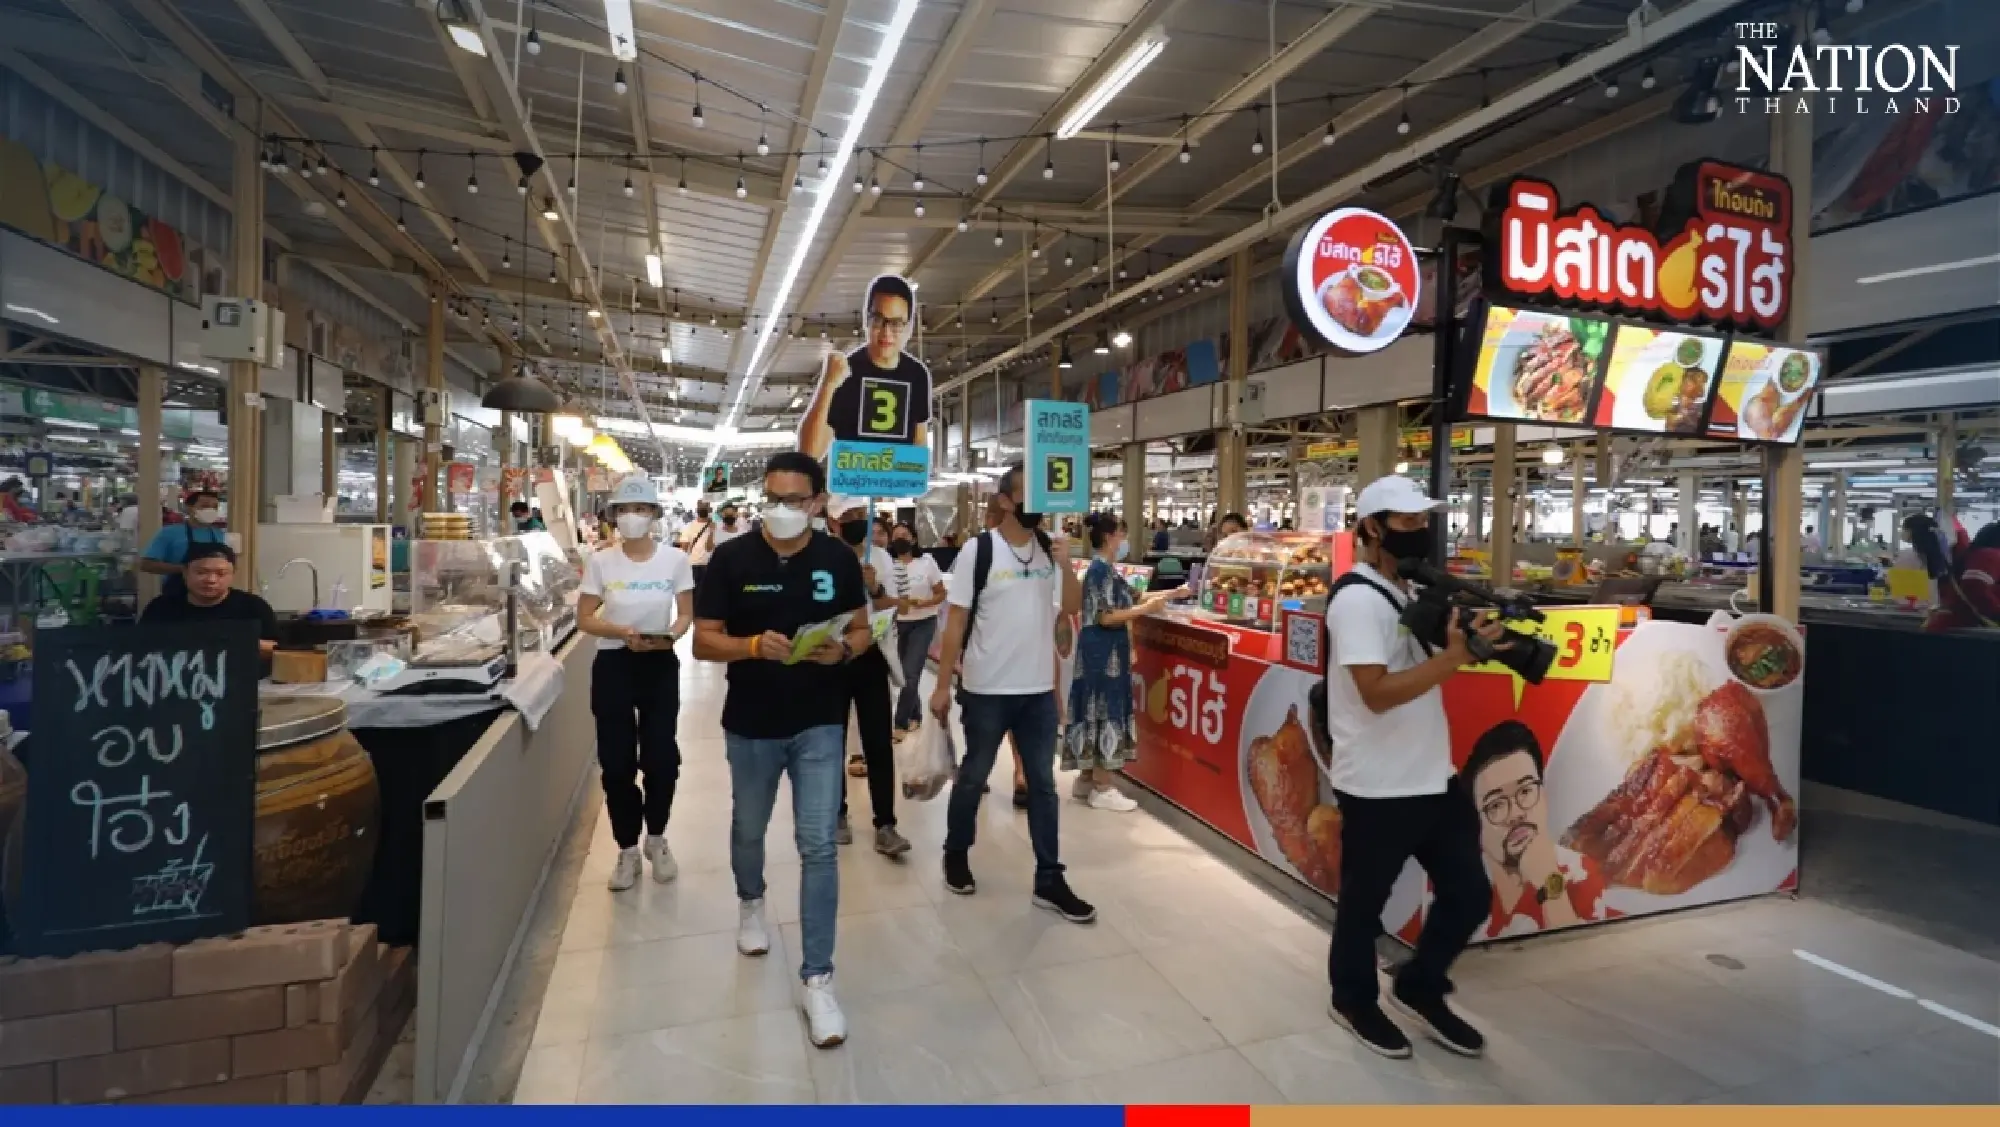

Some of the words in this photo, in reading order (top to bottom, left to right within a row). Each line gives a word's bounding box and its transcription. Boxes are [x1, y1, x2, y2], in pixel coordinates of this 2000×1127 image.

[872, 389, 897, 431] 3
[1052, 461, 1070, 491] 3
[811, 569, 836, 602] 3
[1557, 621, 1585, 669] 3
[90, 723, 183, 768] อบ
